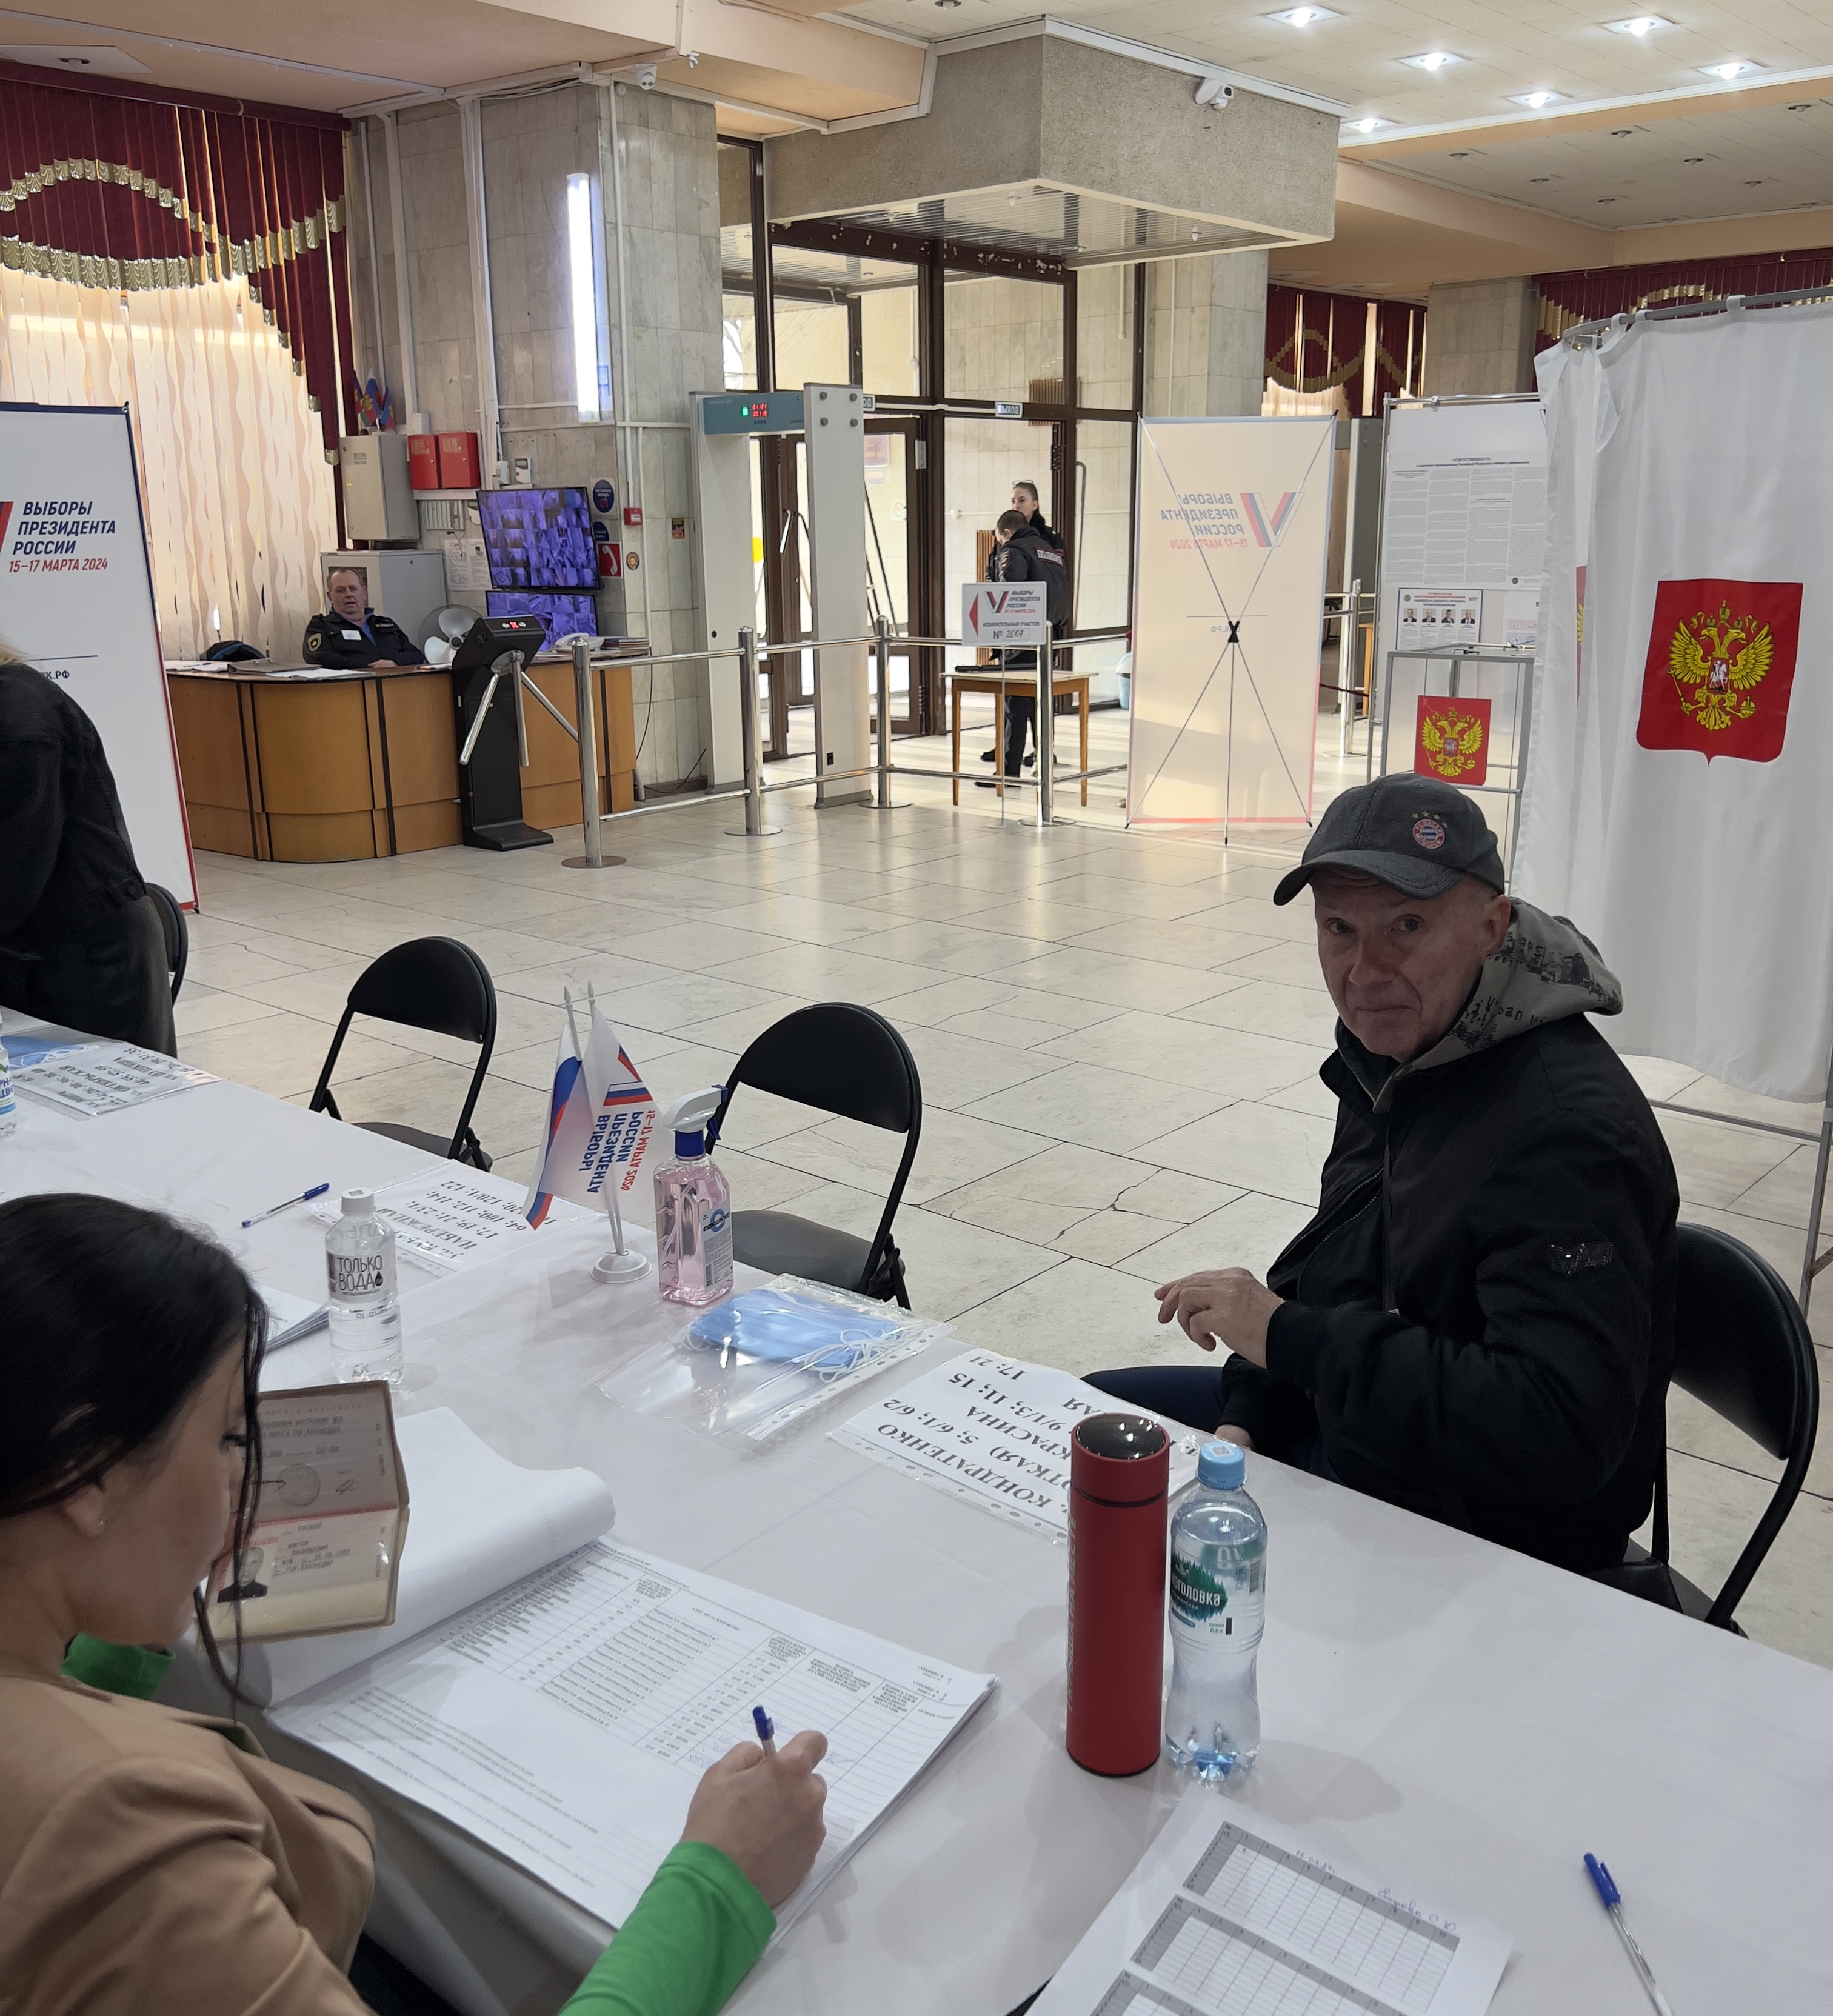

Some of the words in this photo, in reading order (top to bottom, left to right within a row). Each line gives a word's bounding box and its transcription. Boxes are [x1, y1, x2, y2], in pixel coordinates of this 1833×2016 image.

[23, 501, 93, 516] ВЫБОРЫ
[18, 520, 116, 536] ПРЕЗИДЕНТА
[13, 540, 76, 555] РОССИИ
[42, 559, 79, 572] МАРТА
[82, 558, 108, 570] 2024
[45, 670, 70, 680] К.РФ
[441, 1181, 466, 1191] 122
[465, 1187, 502, 1205] 120/1;
[375, 1208, 478, 1250] НАБЕРЕЖНАЯ
[337, 1255, 383, 1273] ТОЛЬКО
[339, 1272, 375, 1291] ВОДА
[969, 1356, 995, 1367] 21
[948, 1373, 977, 1389] 15
[978, 1384, 1009, 1404] 11;
[883, 1399, 916, 1415] 6/2
[917, 1412, 955, 1433] 6/1;
[1010, 1401, 1067, 1430] 9/1/3;
[957, 1430, 980, 1444] 5;
[967, 1406, 1071, 1460] КРАСИНА
[878, 1424, 1053, 1508] КОНДРАТЕНКО
